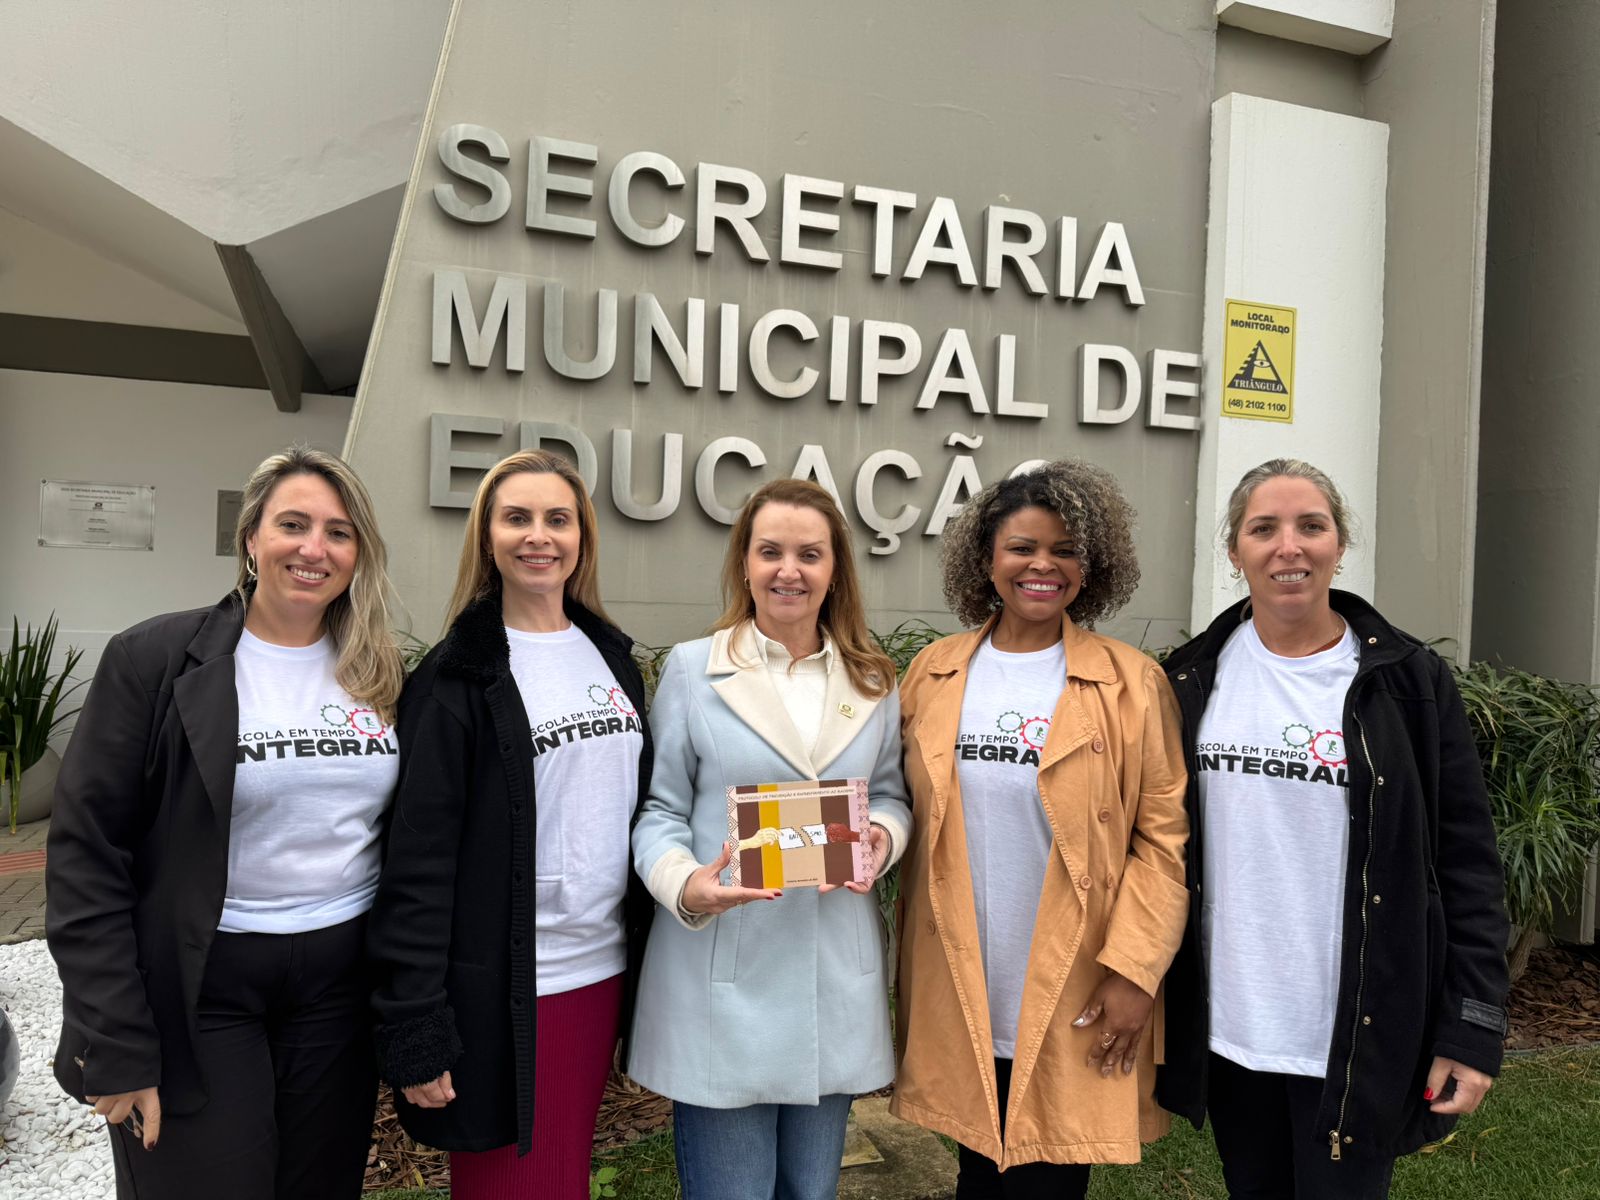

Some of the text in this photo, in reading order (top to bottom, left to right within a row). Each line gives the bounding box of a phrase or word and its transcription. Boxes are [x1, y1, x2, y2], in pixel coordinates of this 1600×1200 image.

[432, 122, 1146, 308] SECRETARIA
[1247, 312, 1274, 323] LOCAL
[1230, 319, 1290, 334] MONITORADO
[430, 269, 1204, 431] MUNICIPAL DE
[1233, 377, 1284, 392] TRIÂNGULO
[1228, 398, 1287, 412] (48) 2102 1100
[430, 413, 1052, 556] EDUCAÇÃ
[530, 707, 618, 737] SCOLA EM TEMPO
[236, 729, 356, 744] SCOLA EM TEMPO
[960, 734, 1019, 745] EM TEMPO
[236, 738, 398, 764] NTEGRAL
[1241, 745, 1259, 755] EM
[1264, 747, 1309, 761] TEMPO
